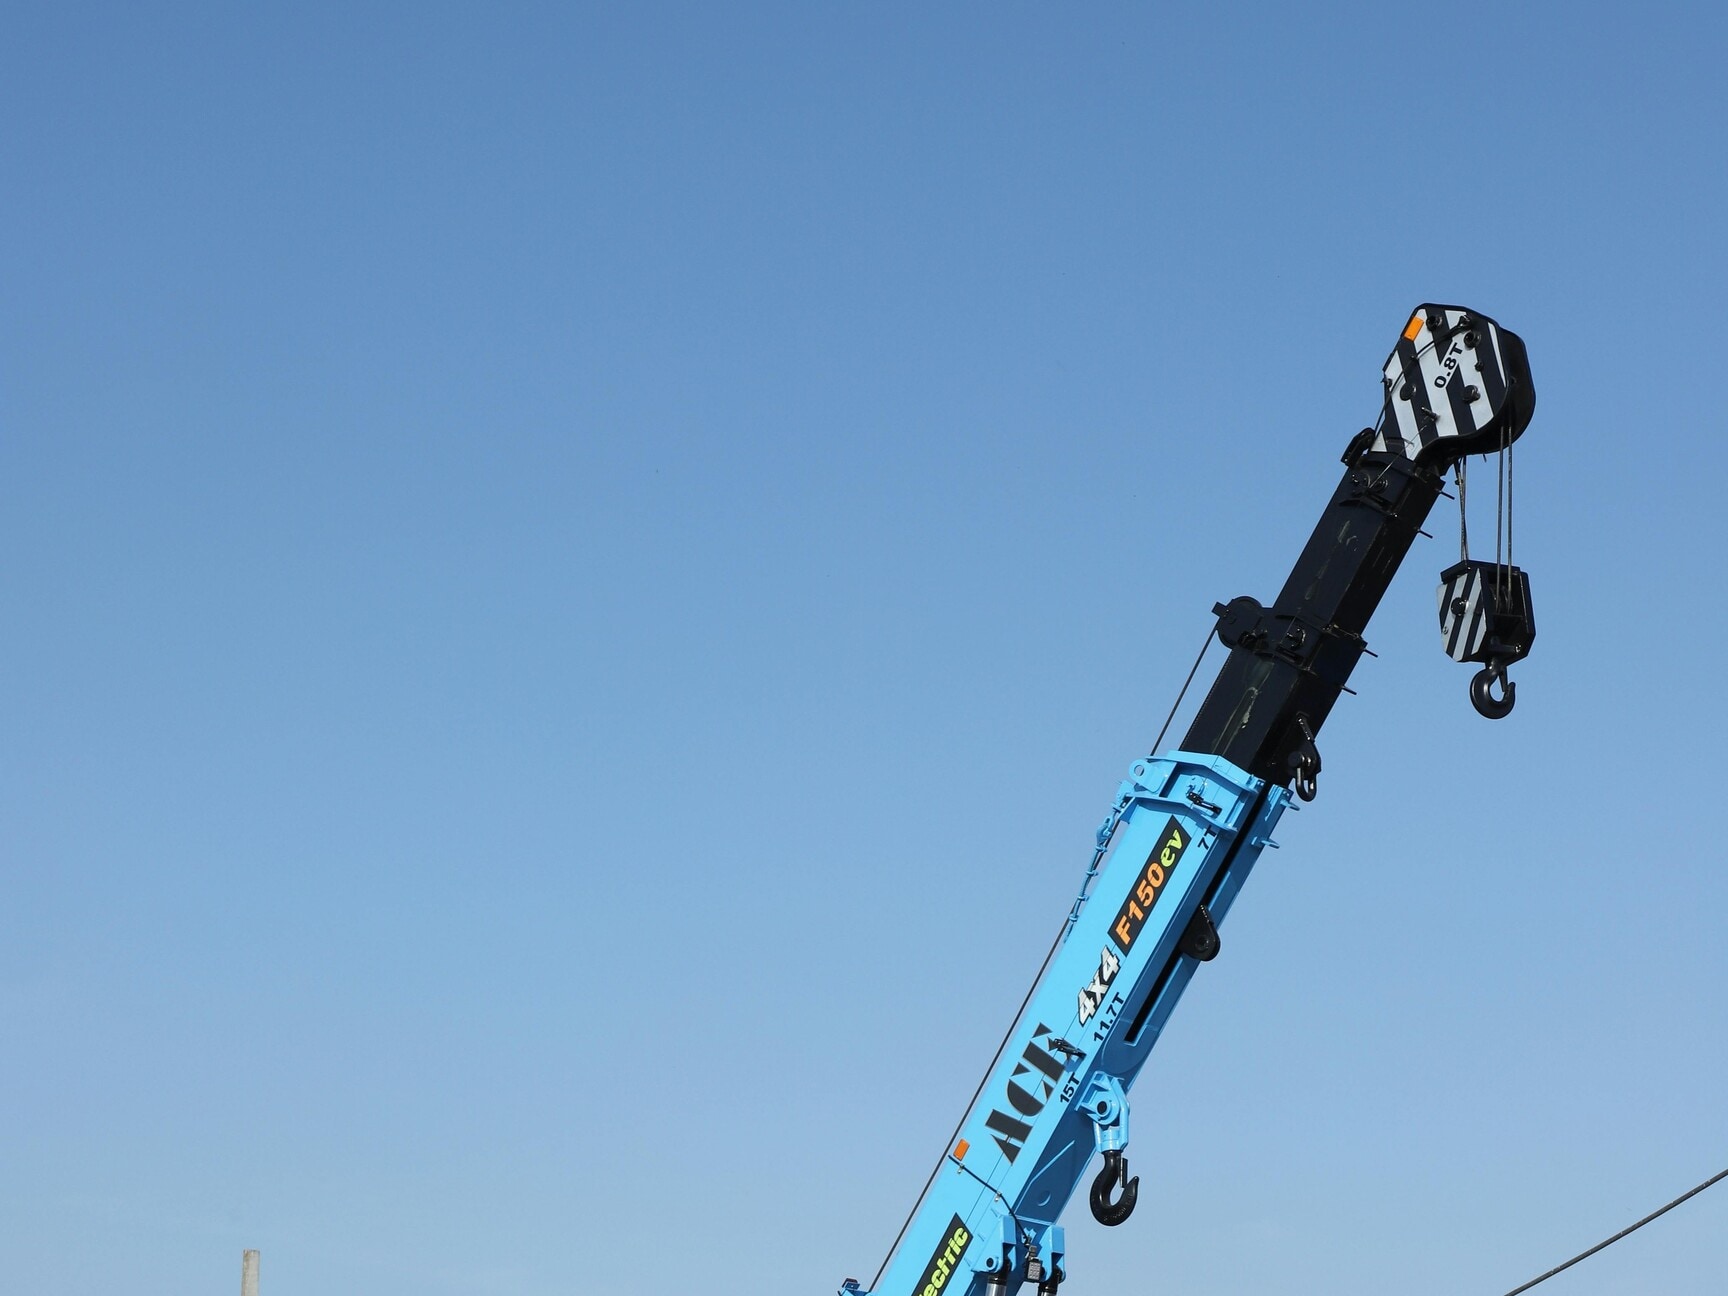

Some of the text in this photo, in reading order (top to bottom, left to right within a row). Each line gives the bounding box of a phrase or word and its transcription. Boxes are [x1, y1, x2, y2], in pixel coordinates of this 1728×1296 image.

[1433, 342, 1463, 389] 0.8T
[1198, 825, 1217, 850] 7T
[1077, 945, 1121, 1027] 4x4
[1093, 991, 1124, 1043] 11.7T
[984, 1021, 1076, 1165] ACE
[1060, 1073, 1080, 1103] 15T
